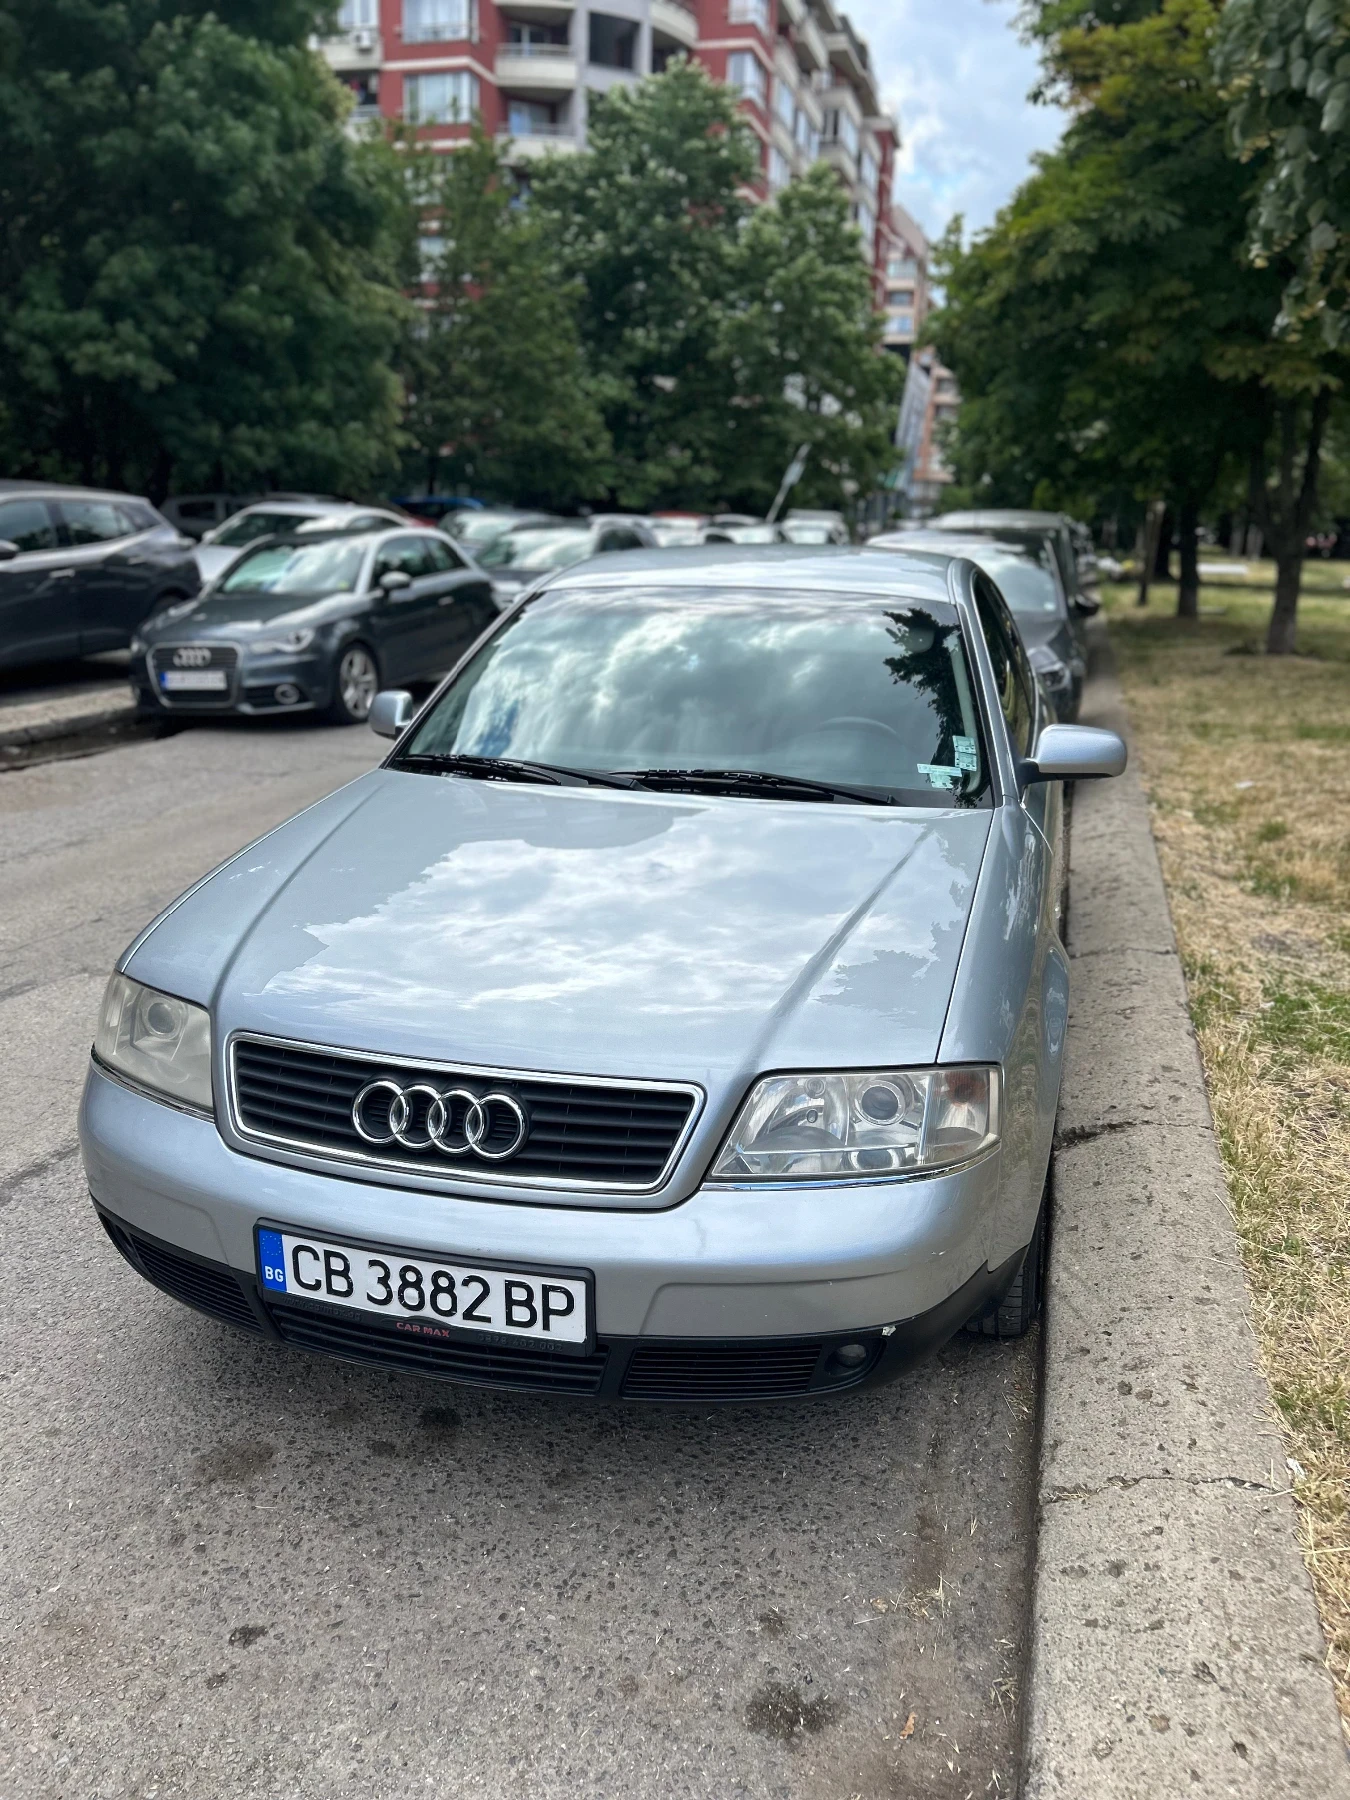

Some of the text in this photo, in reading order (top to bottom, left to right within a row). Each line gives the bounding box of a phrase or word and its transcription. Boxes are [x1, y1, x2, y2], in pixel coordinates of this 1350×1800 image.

[264, 1265, 285, 1283] BG
[292, 1244, 575, 1332] CB 3882 BP
[396, 1322, 450, 1338] CAR MAX
